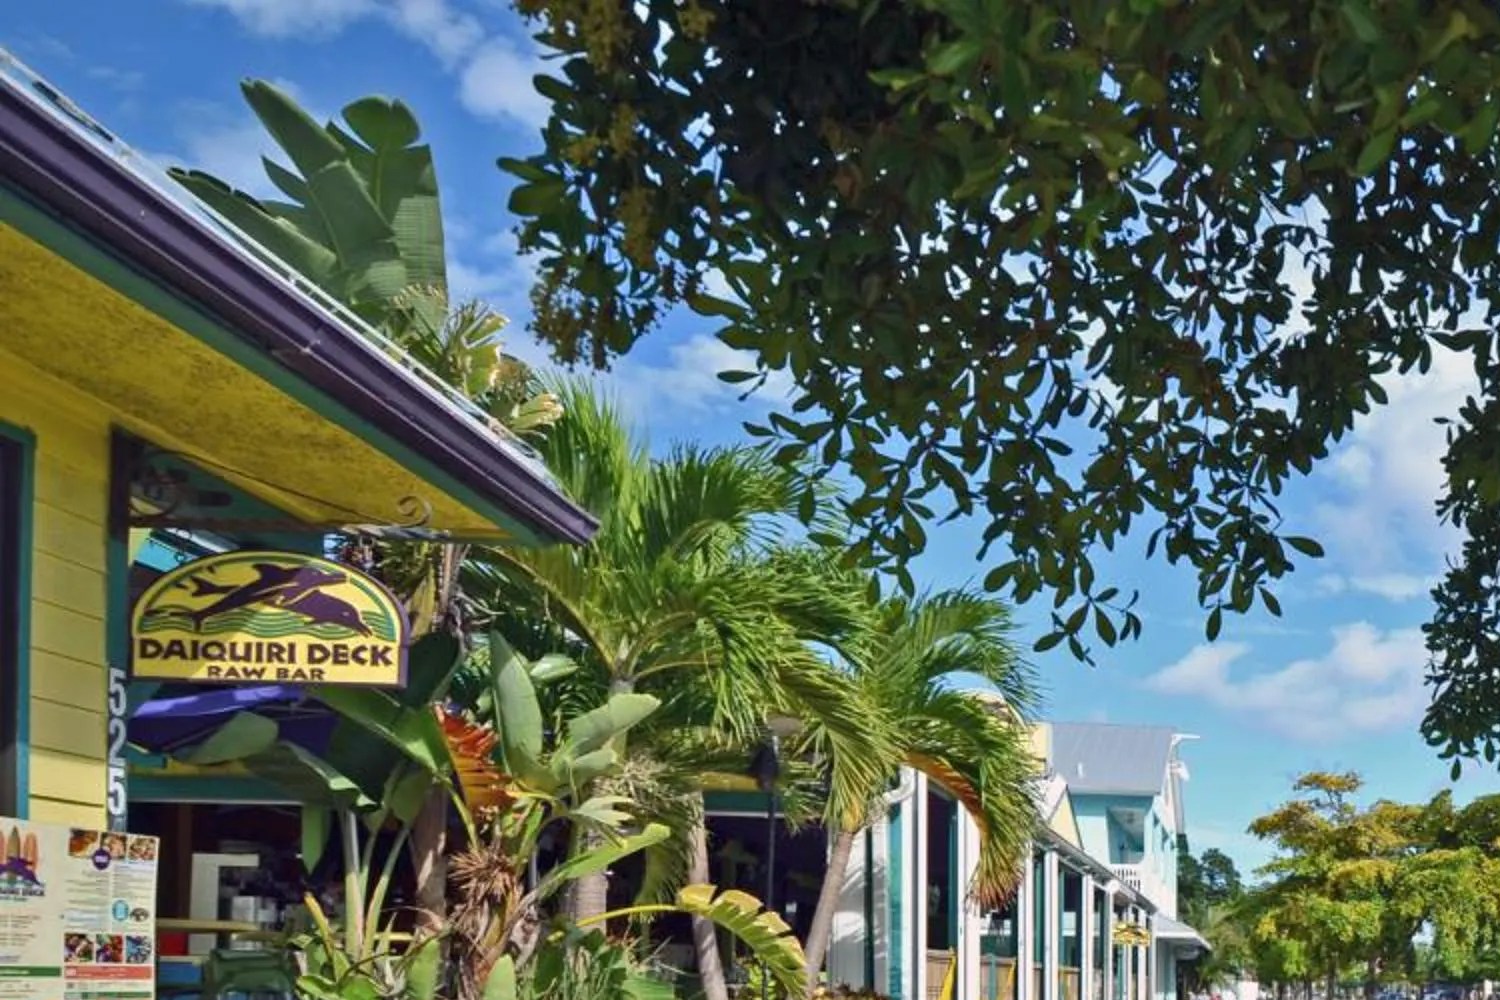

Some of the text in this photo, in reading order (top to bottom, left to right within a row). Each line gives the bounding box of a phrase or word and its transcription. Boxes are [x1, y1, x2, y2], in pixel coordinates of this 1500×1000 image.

[139, 638, 393, 667] DAIQUIRI DECK
[206, 664, 326, 681] RAW BAR
